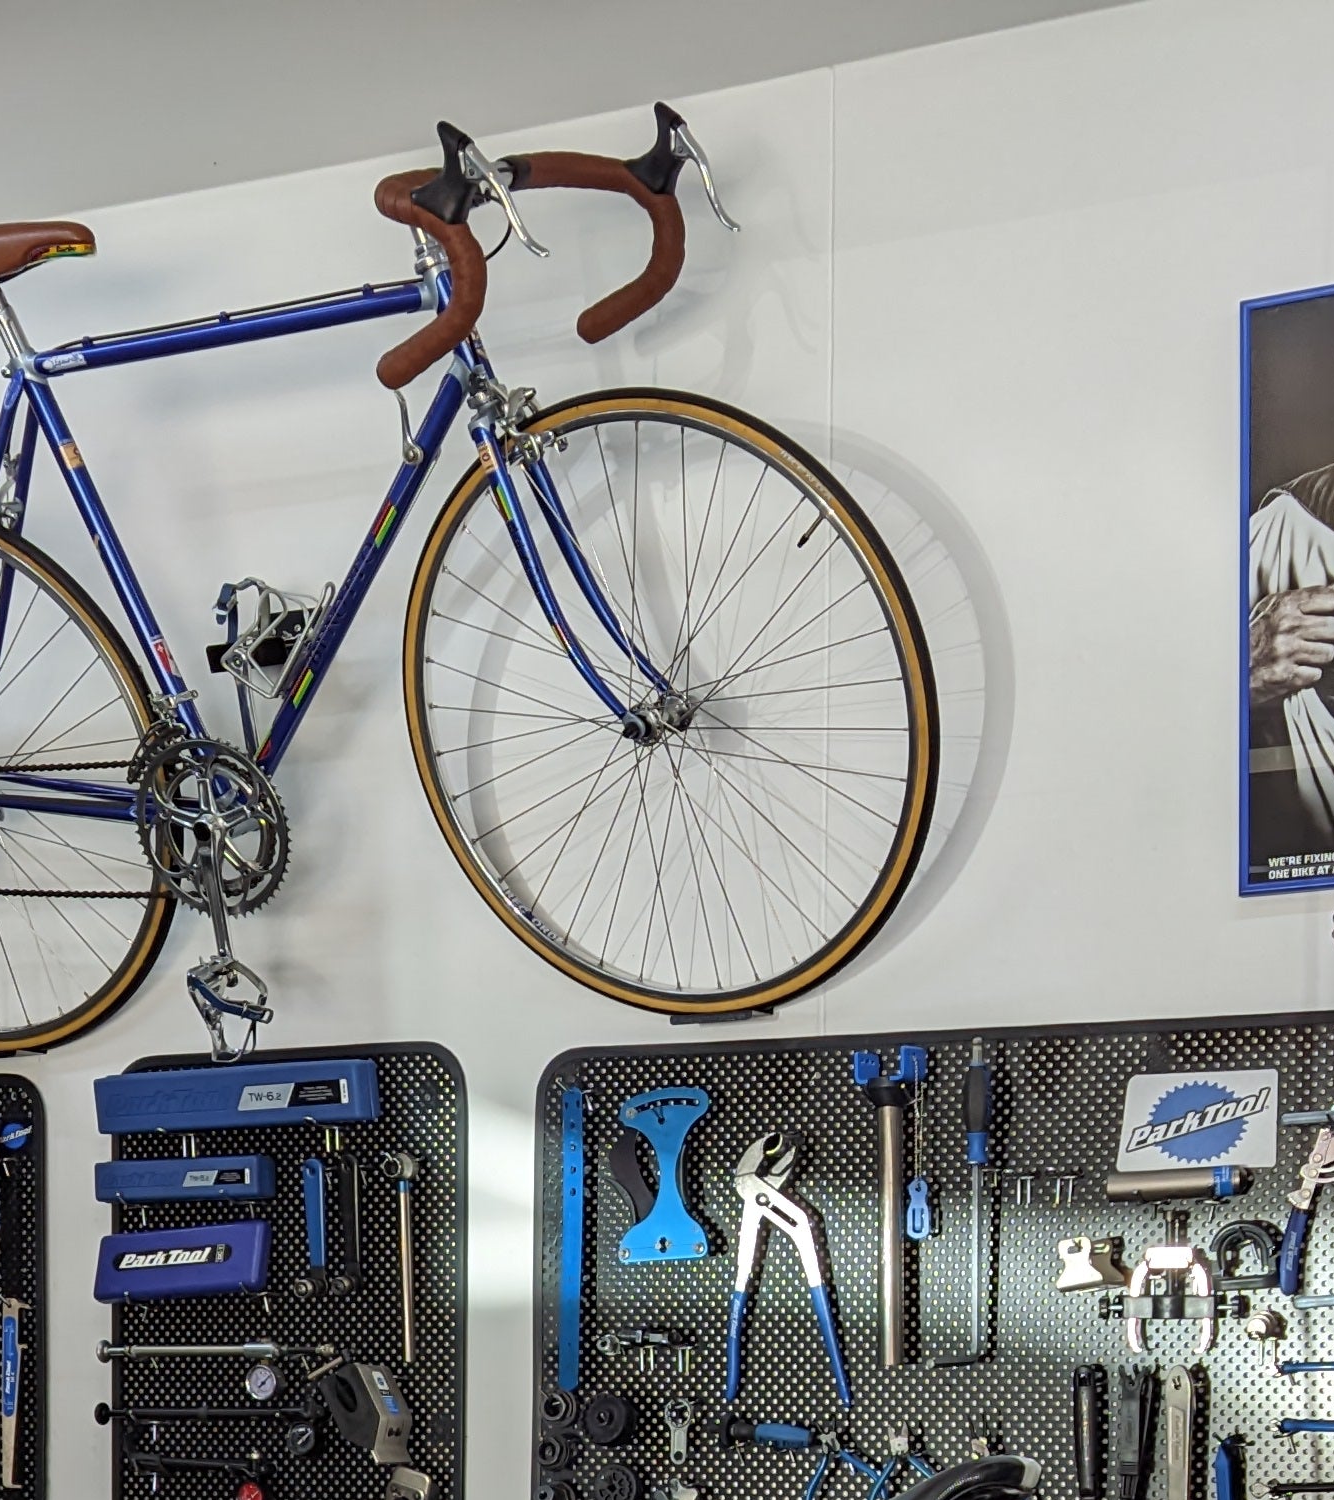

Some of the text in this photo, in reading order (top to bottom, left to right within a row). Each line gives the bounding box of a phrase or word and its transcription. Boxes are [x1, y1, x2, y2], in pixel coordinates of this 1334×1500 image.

[1268, 854, 1302, 868] WE'RE
[1268, 868, 1291, 880] ONE
[1292, 866, 1316, 878] BIKE
[1317, 864, 1331, 876] AT
[1126, 1088, 1271, 1153] ParkTool
